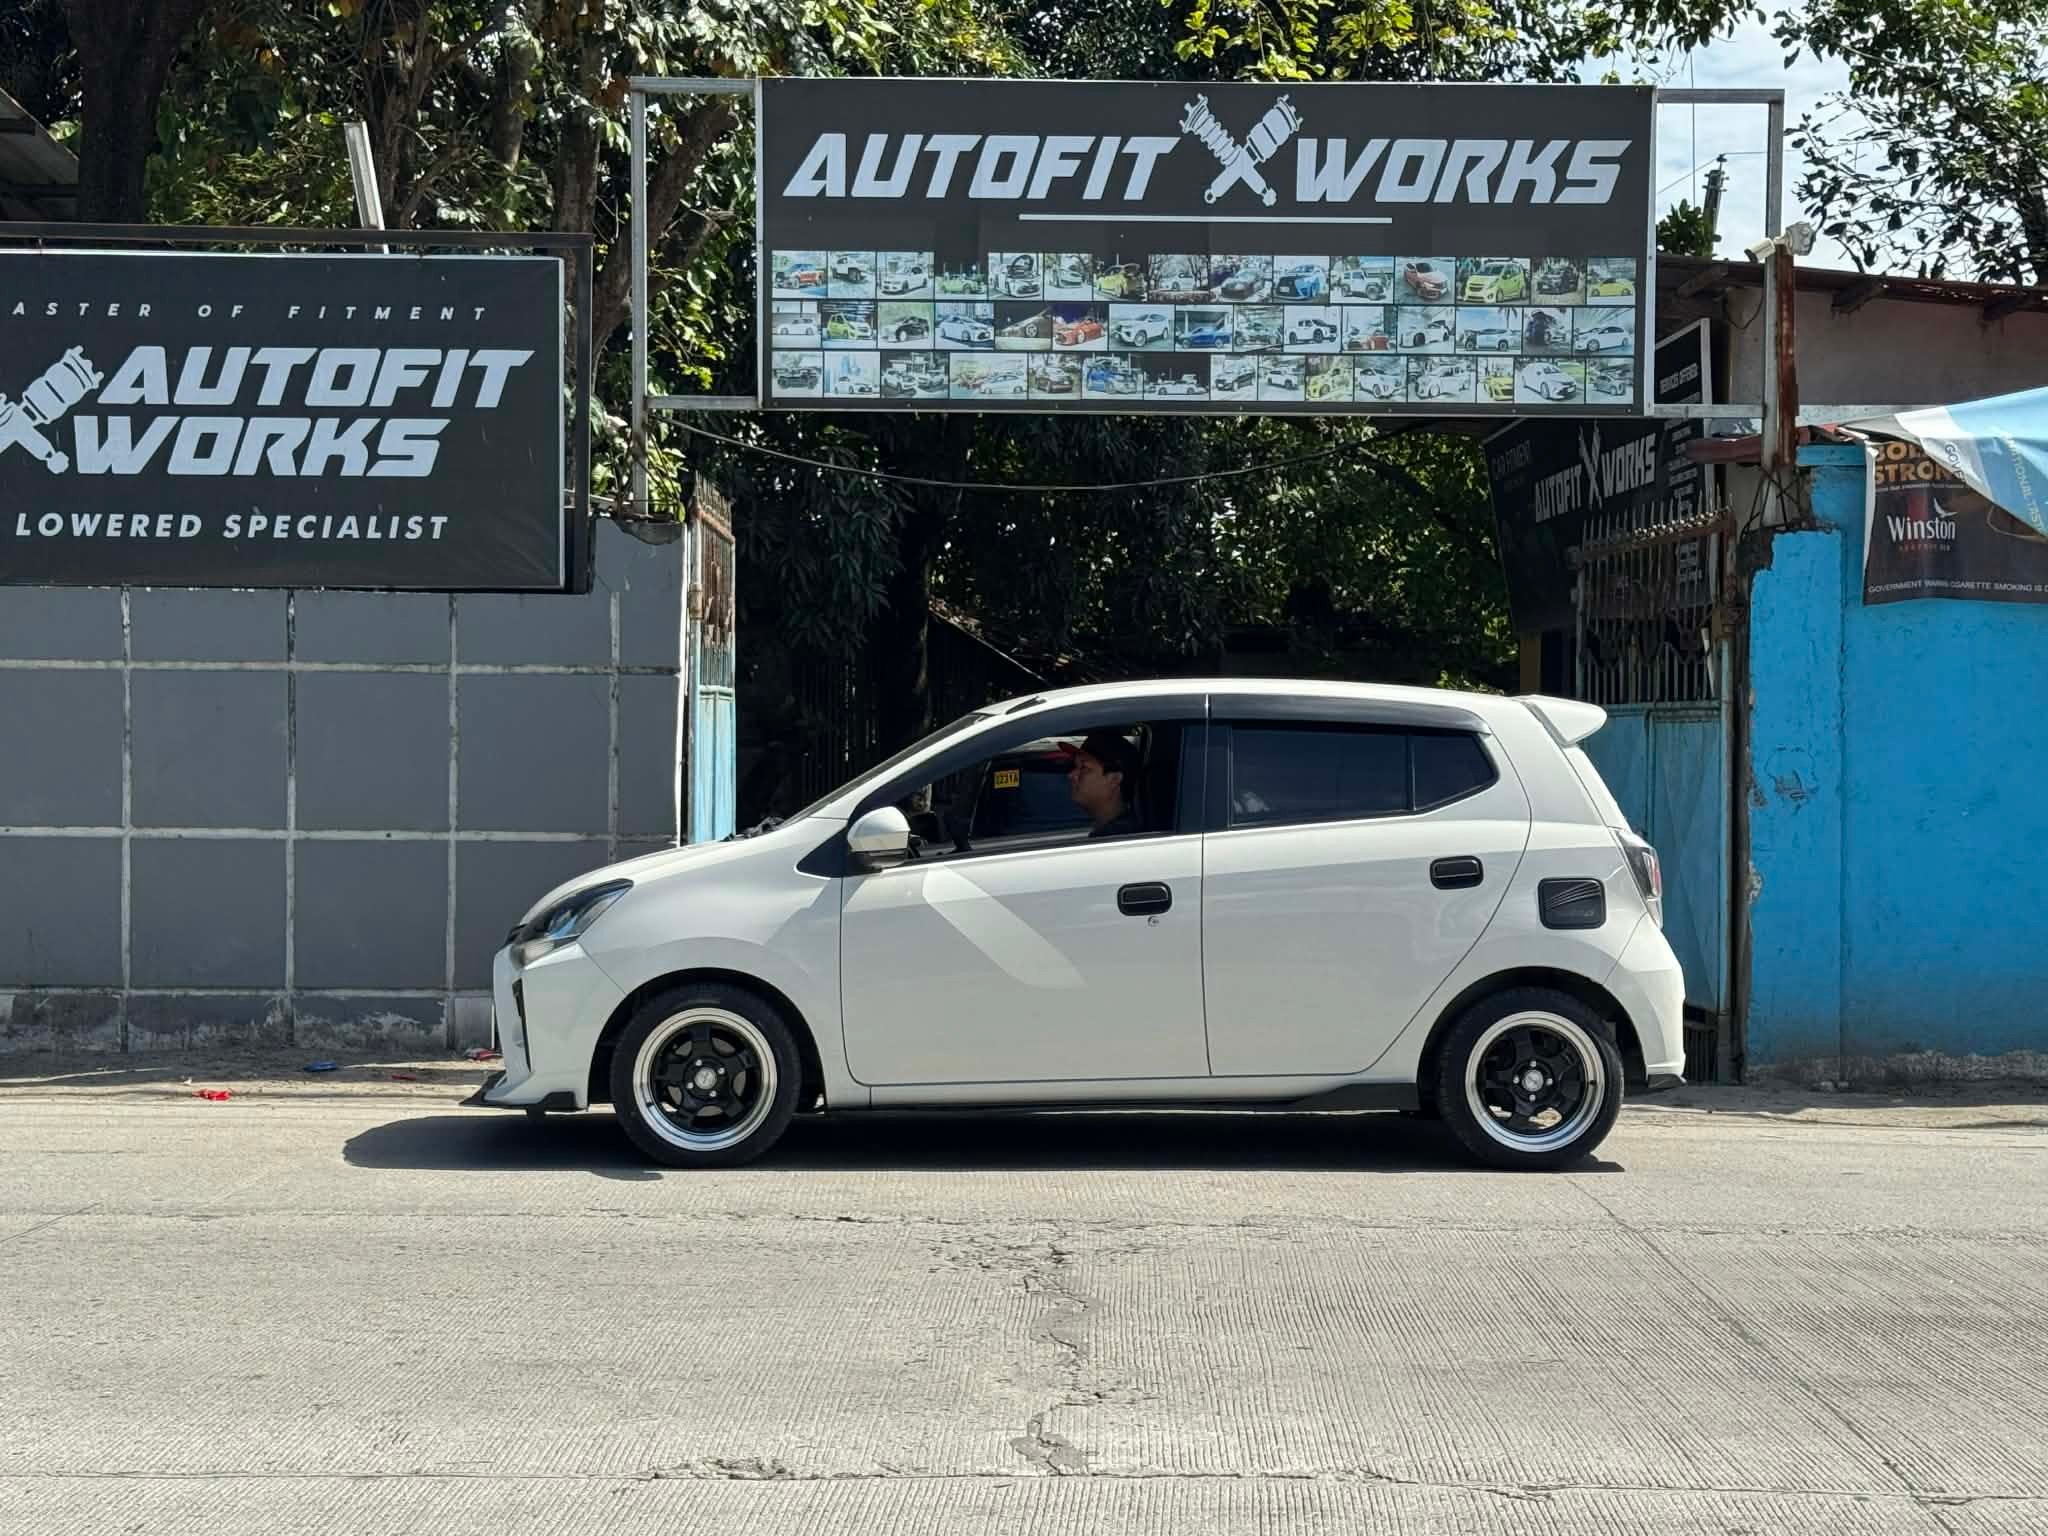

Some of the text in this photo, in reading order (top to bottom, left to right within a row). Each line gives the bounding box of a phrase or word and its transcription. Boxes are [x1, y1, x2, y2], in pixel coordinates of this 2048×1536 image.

[782, 132, 1633, 204] AUTOFIT WORKS
[197, 304, 244, 318] OF
[287, 305, 486, 321] FITMENT
[97, 345, 536, 408] AUTOFIT
[73, 415, 451, 477] WORKS
[1535, 463, 1584, 523] AUTOFIT
[1601, 432, 1657, 499] WORKS
[15, 512, 448, 540] LOWERED SPECIALIST
[1886, 514, 1956, 542] Winston
